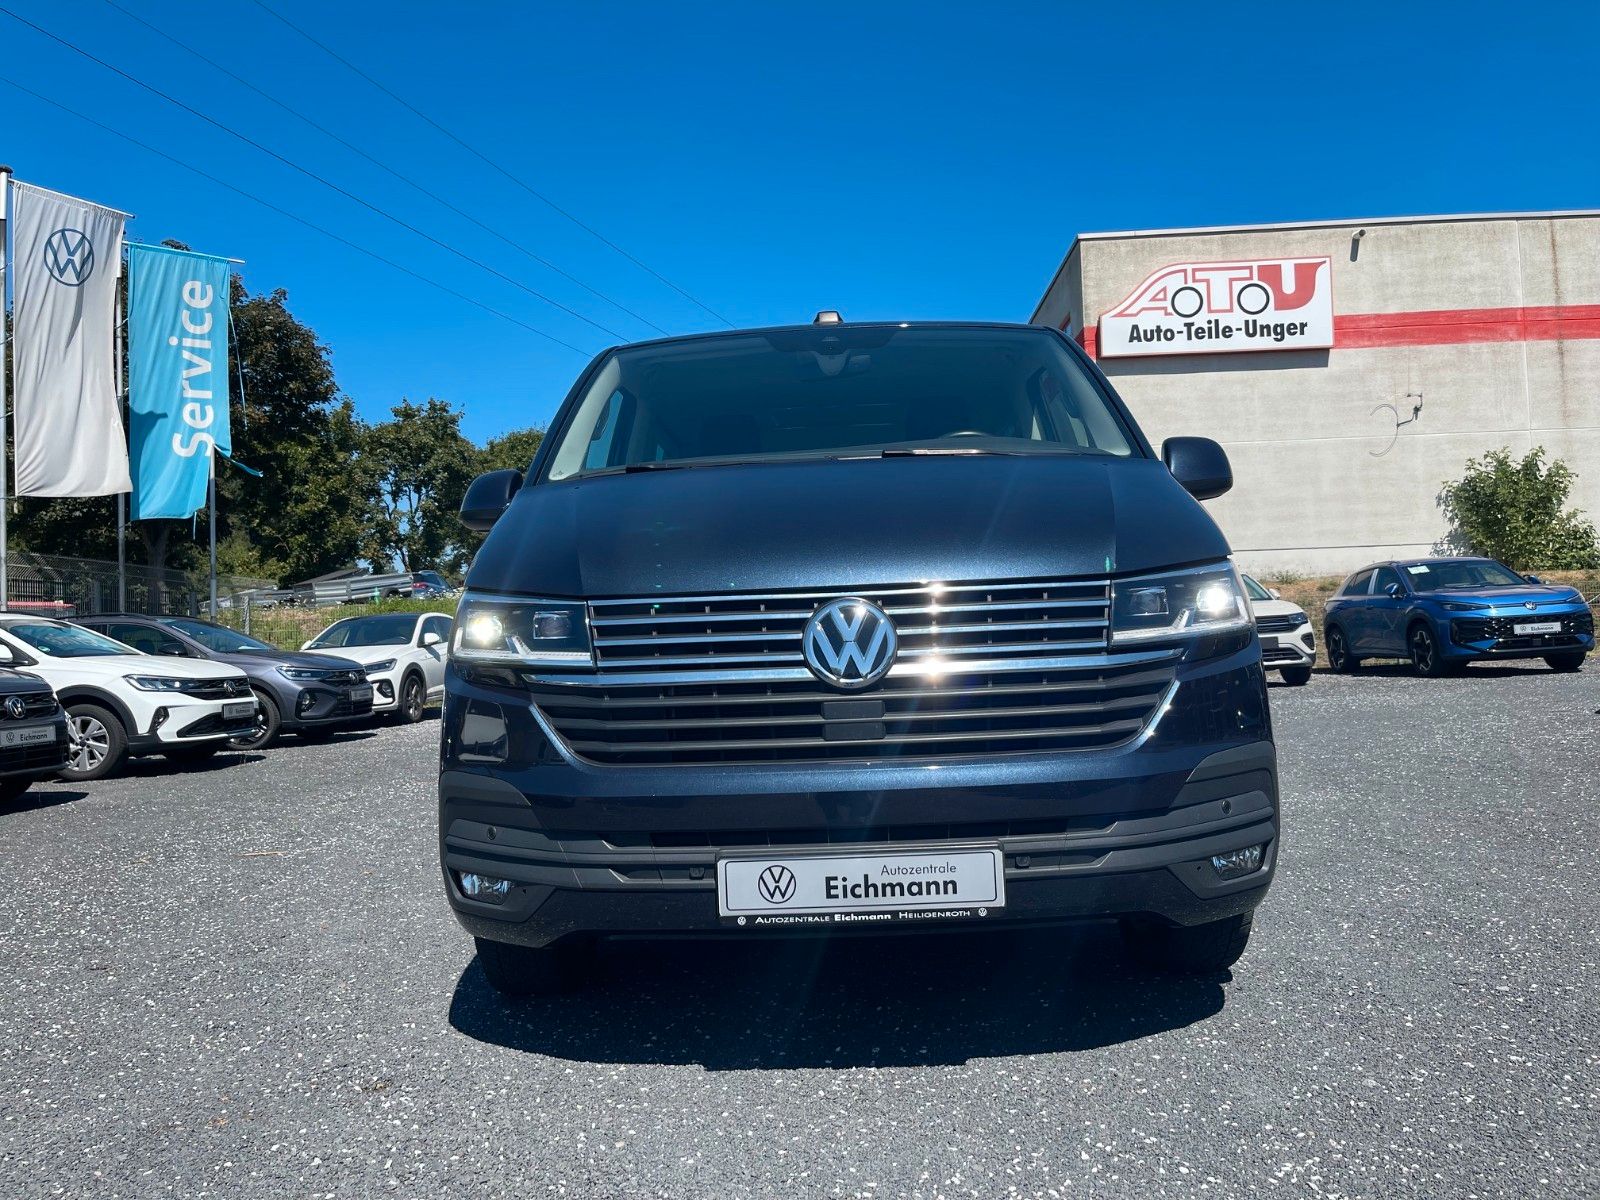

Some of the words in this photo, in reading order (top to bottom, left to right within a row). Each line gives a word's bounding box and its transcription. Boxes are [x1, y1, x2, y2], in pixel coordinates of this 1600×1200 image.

[1128, 319, 1308, 343] Auto-Teile-Unger
[169, 280, 215, 458] Service
[880, 862, 957, 877] Autozentrale
[825, 874, 958, 899] Eichmann
[755, 915, 830, 925] AUTOZENTRALE
[834, 913, 892, 922] Eichmann
[898, 910, 971, 920] HEILIGENROTH
